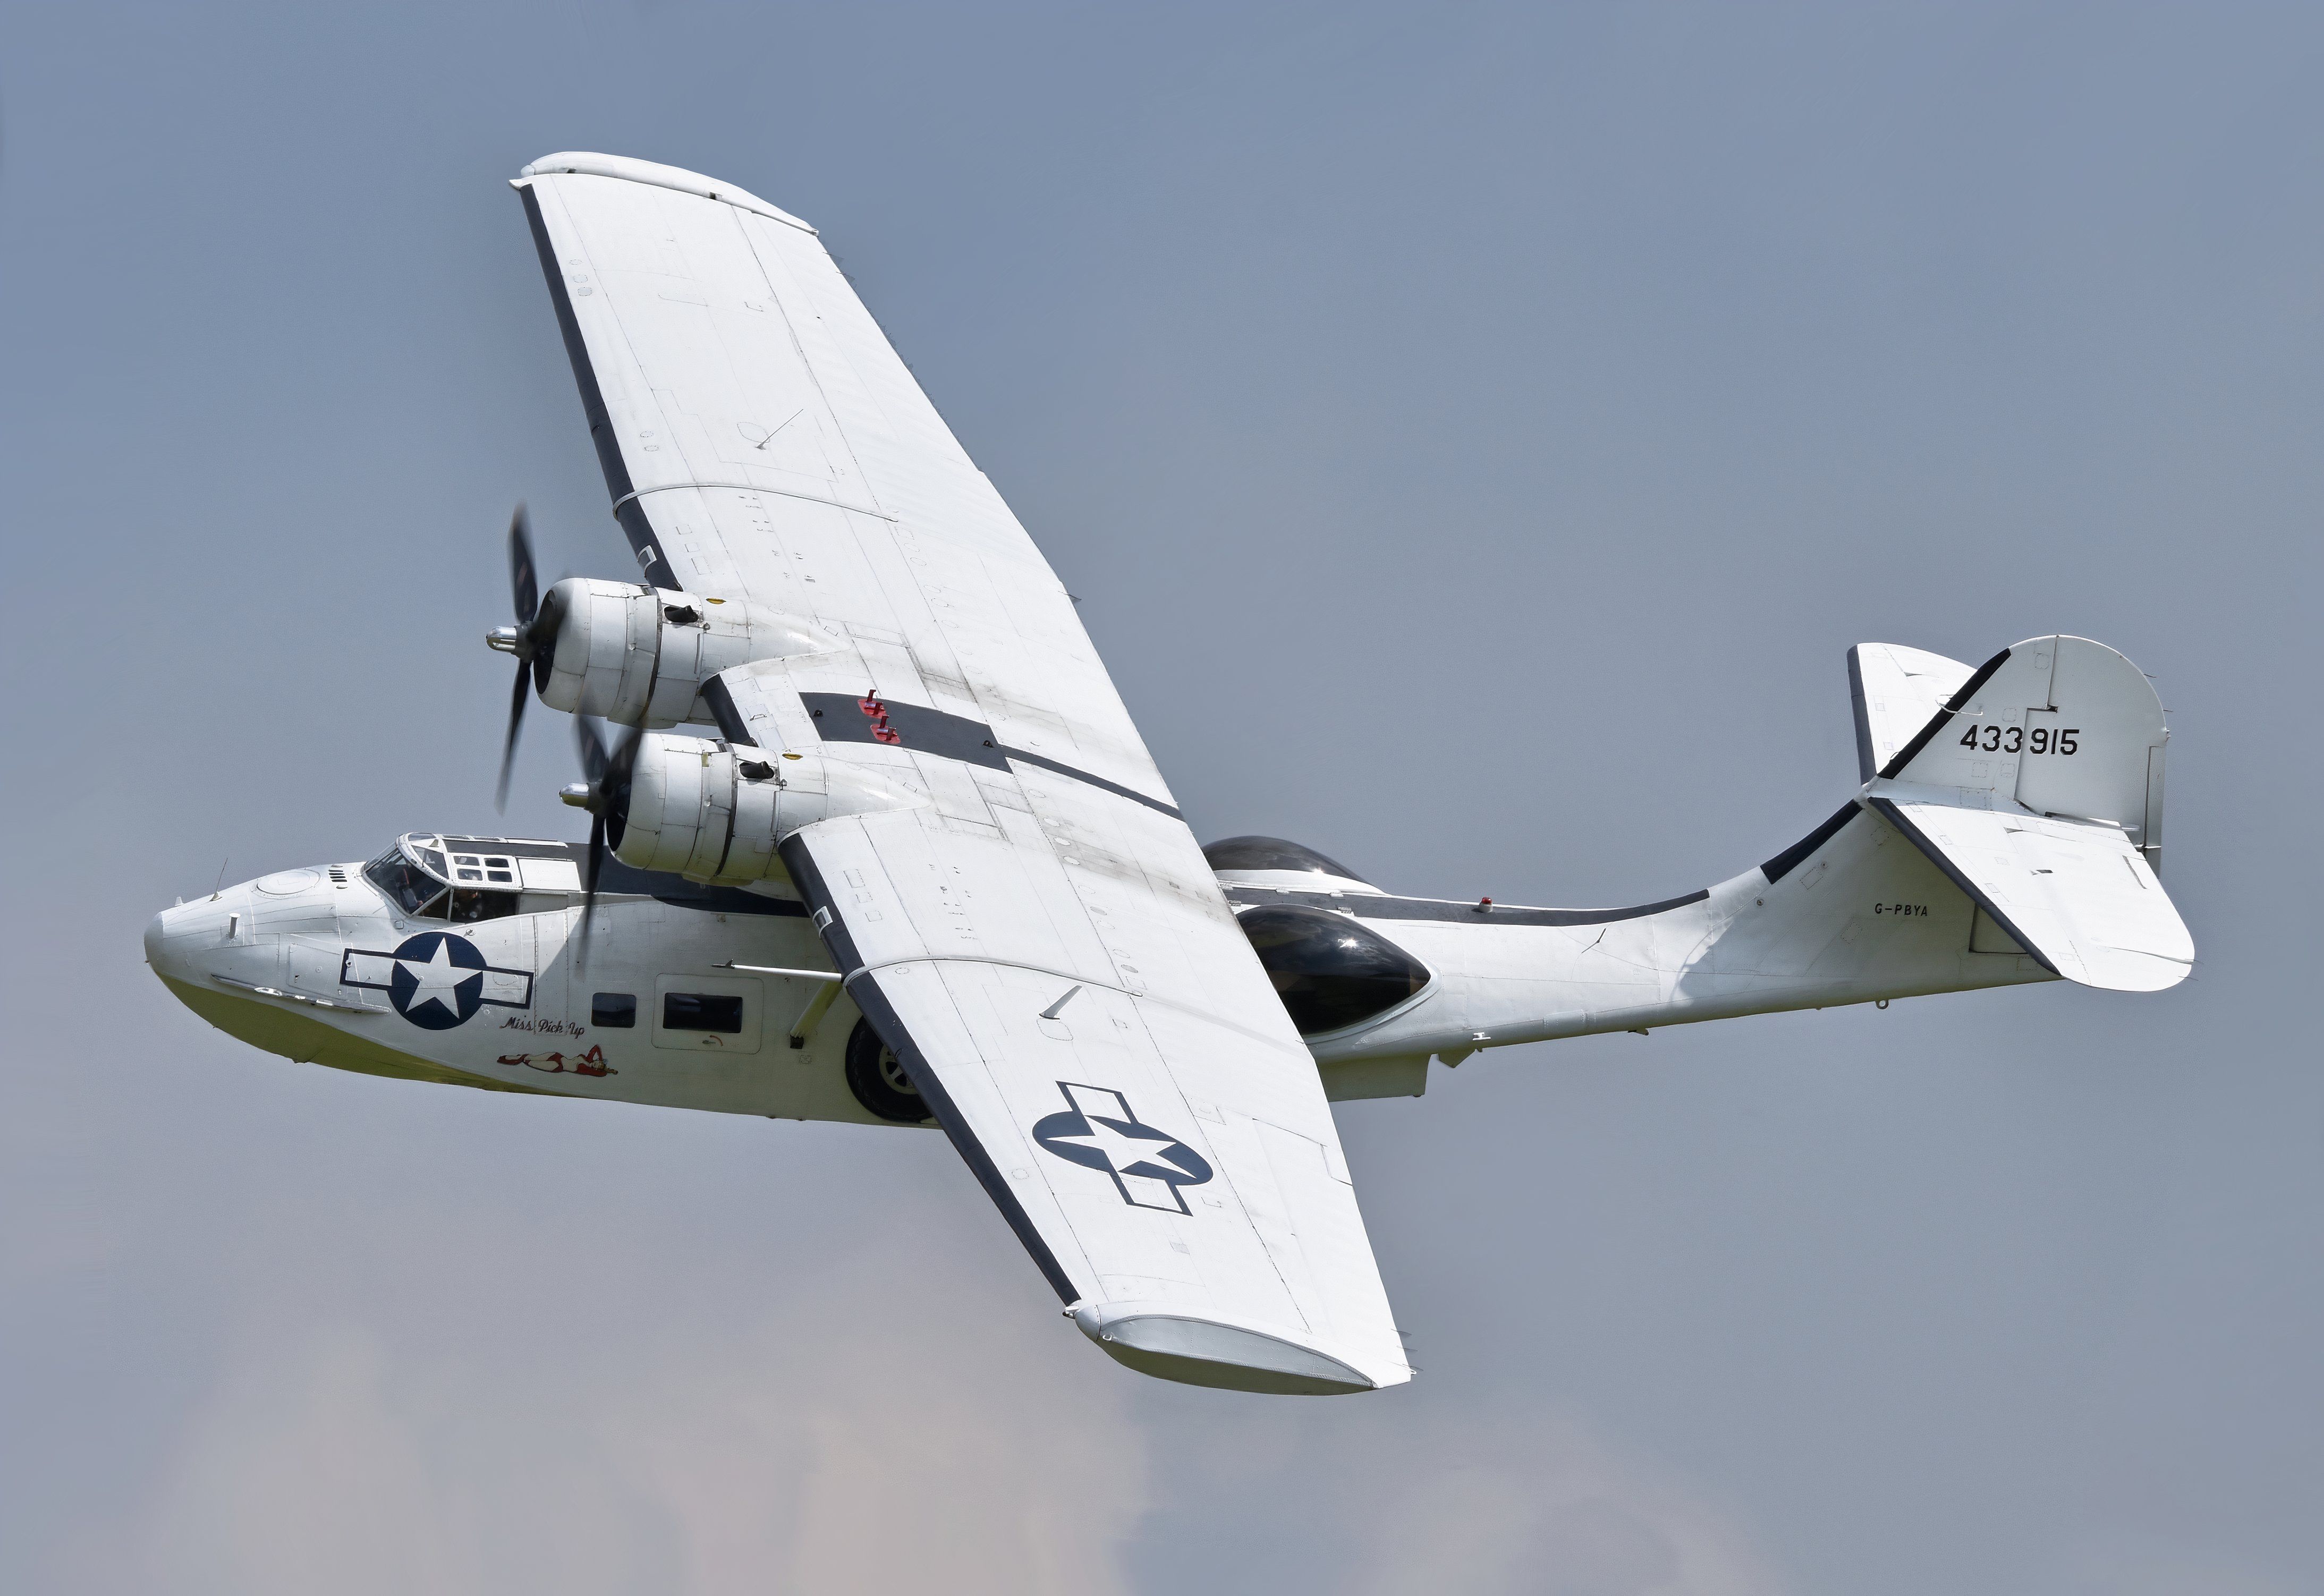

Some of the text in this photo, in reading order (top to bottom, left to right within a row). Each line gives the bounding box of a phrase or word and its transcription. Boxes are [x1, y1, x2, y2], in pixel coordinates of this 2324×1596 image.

[1960, 724, 2080, 755] 433915
[1875, 903, 1928, 916] G-PBYA
[499, 1016, 585, 1040] Miss Pick Up
